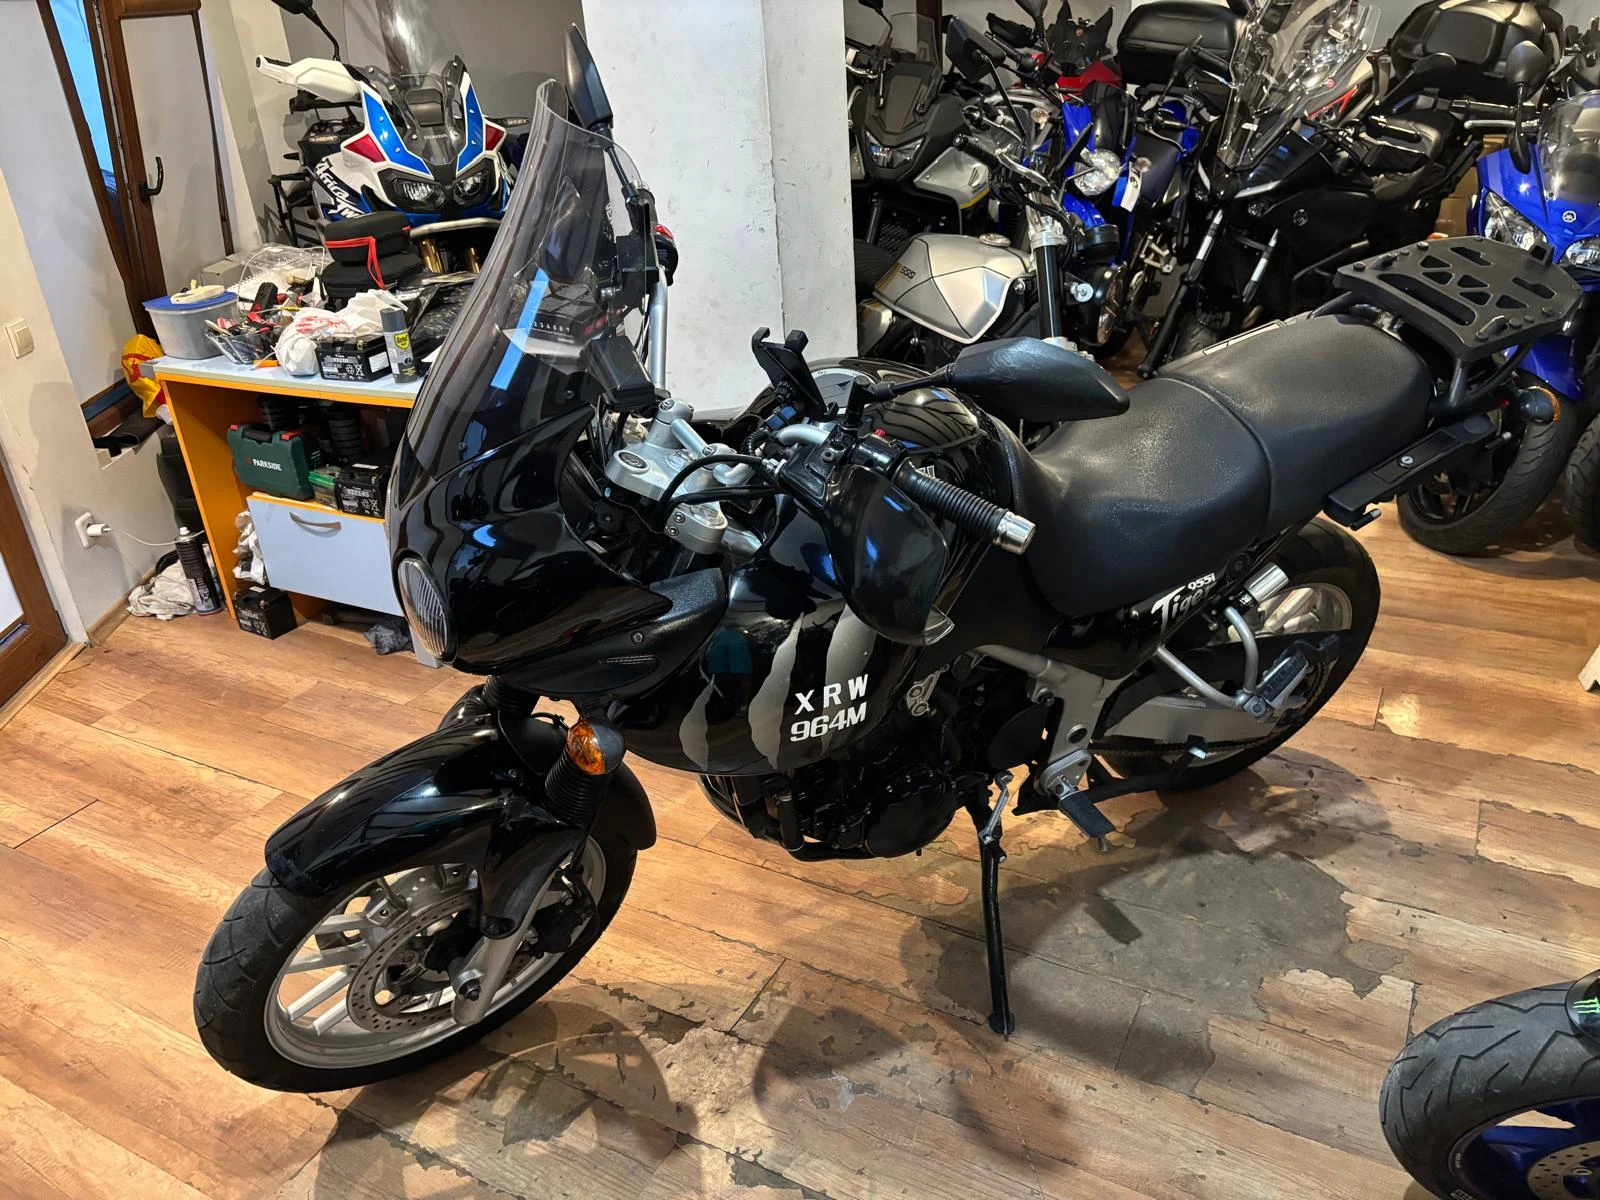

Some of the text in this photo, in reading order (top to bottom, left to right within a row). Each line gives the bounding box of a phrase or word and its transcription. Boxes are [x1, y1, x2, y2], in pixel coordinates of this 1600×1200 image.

[252, 458, 282, 471] PARKSIDE
[1150, 581, 1217, 637] Tiger
[790, 701, 867, 742] 964M
